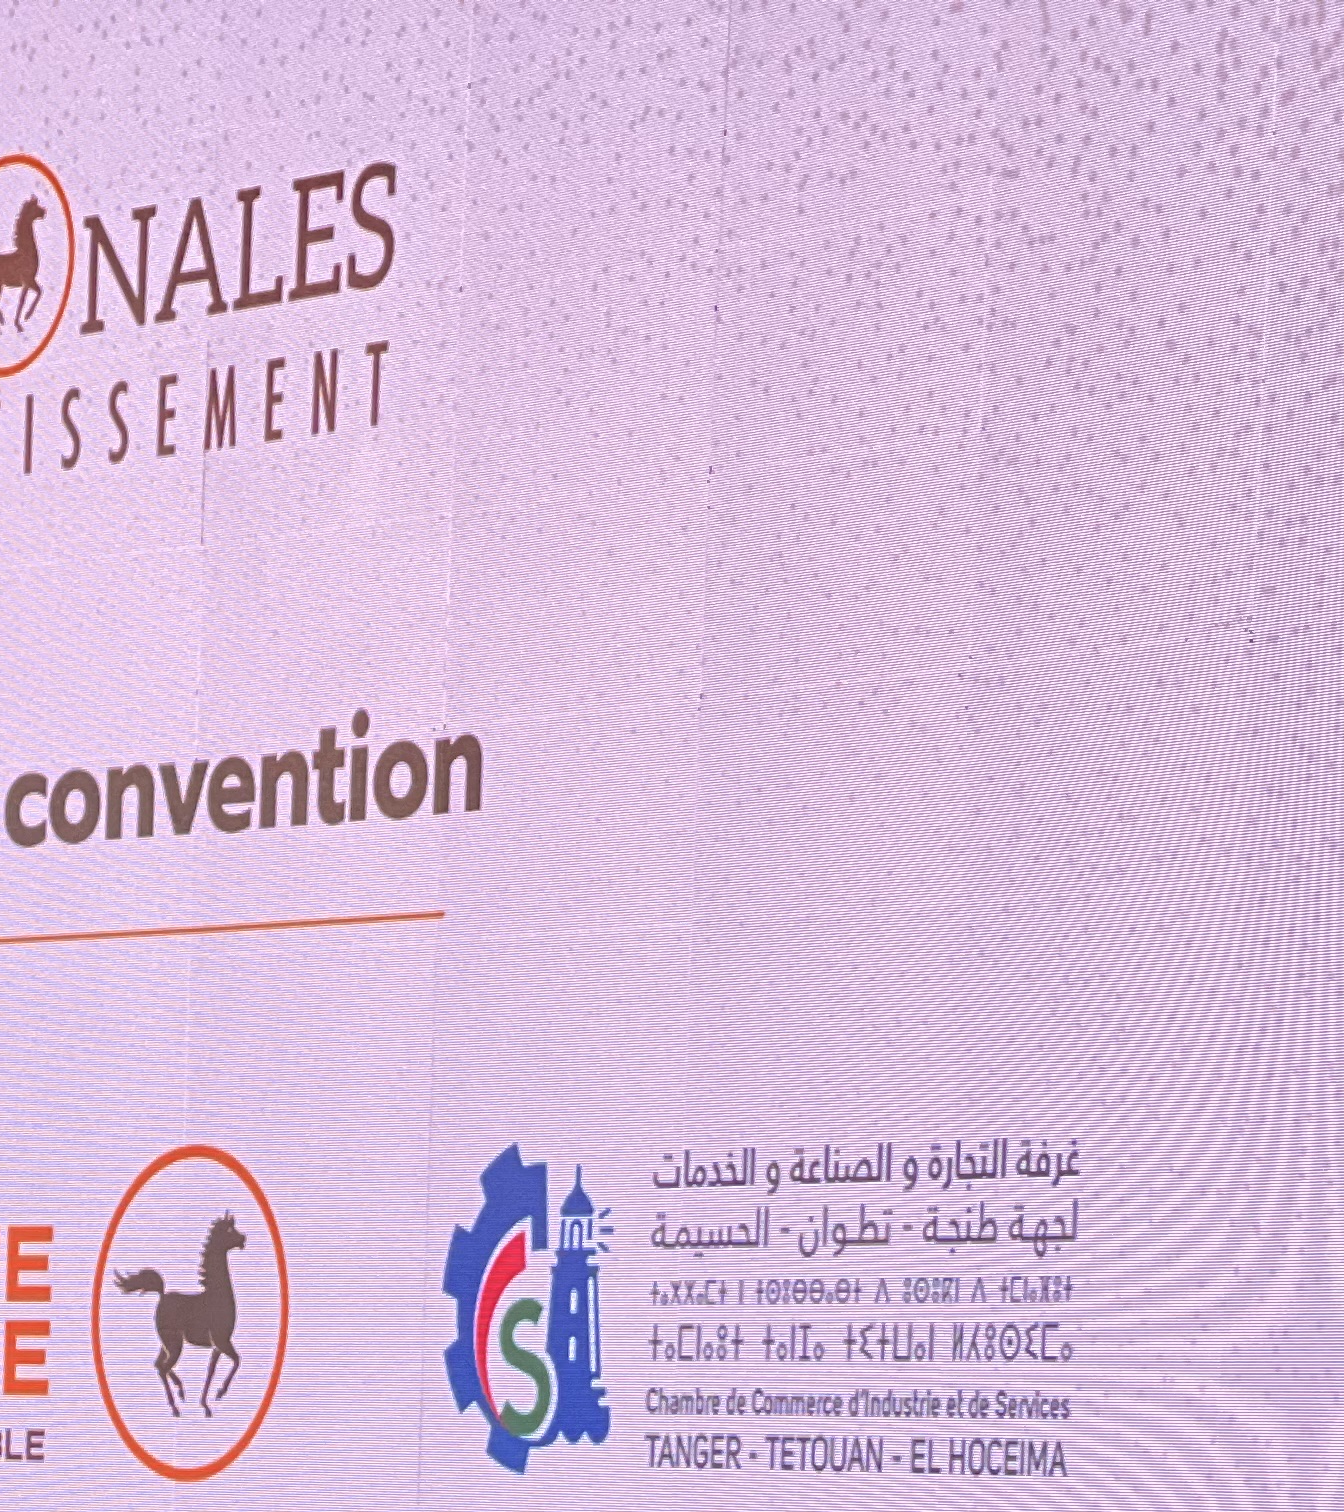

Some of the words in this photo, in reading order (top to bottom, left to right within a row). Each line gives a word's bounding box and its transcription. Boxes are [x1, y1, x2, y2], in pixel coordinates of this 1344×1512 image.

[3, 706, 483, 846] convention
[652, 1147, 757, 1188] الخدمات
[789, 1141, 894, 1185] الصناعة
[928, 1137, 1009, 1191] التجارة
[1015, 1138, 1080, 1188] غرفة
[651, 1205, 770, 1259] الحسيمة
[797, 1203, 894, 1258] تطوان
[923, 1200, 998, 1255] طنجة
[645, 1386, 720, 1415] Chambre
[725, 1386, 747, 1415] de
[751, 1387, 843, 1416] Commerce
[848, 1388, 941, 1418] d'Industrie
[968, 1389, 990, 1419] de
[995, 1389, 1072, 1420] Services
[644, 1433, 742, 1470] TANGER
[765, 1435, 884, 1473] TETOUAN
[911, 1437, 942, 1474] EL
[948, 1437, 1068, 1477] HOCEIMA
